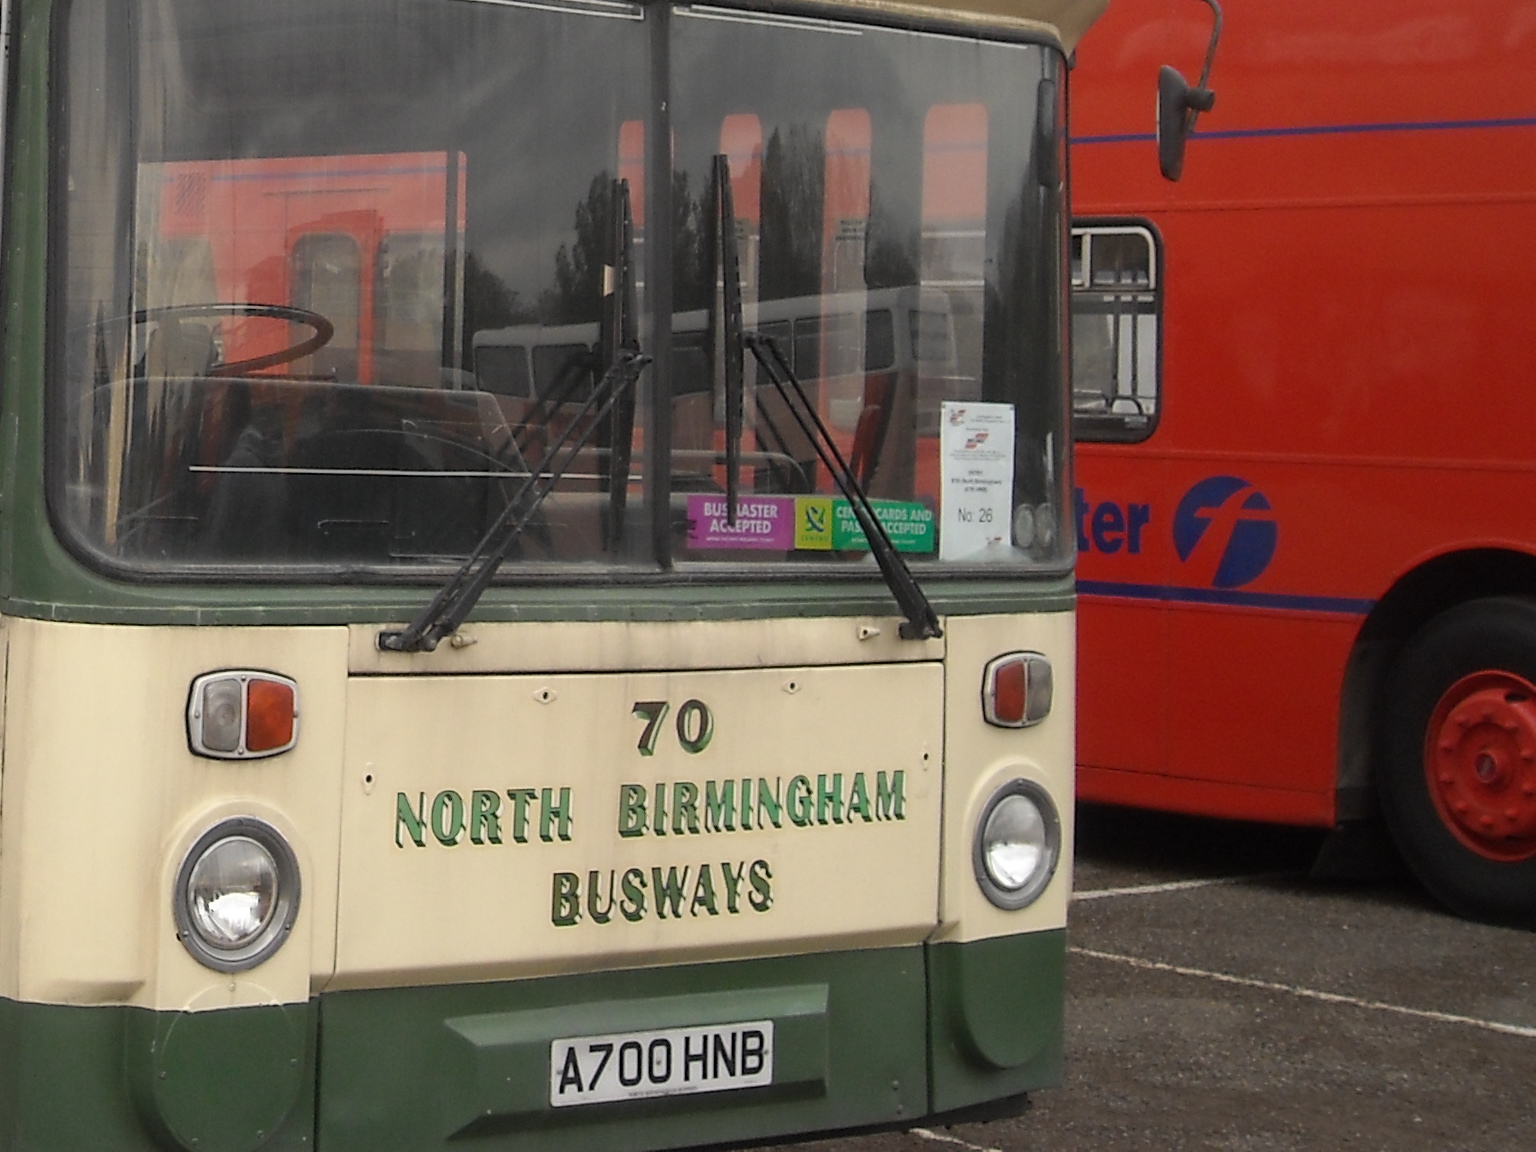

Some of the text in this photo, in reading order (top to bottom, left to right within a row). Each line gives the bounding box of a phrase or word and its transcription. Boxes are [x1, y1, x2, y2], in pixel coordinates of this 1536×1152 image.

[910, 510, 932, 521] AND
[978, 508, 993, 523] 26
[631, 699, 715, 756] 70
[395, 769, 907, 848] NORTH BIRMINGHAM
[550, 859, 775, 927] BUSWAYS
[559, 1030, 765, 1095] A700 HNB
